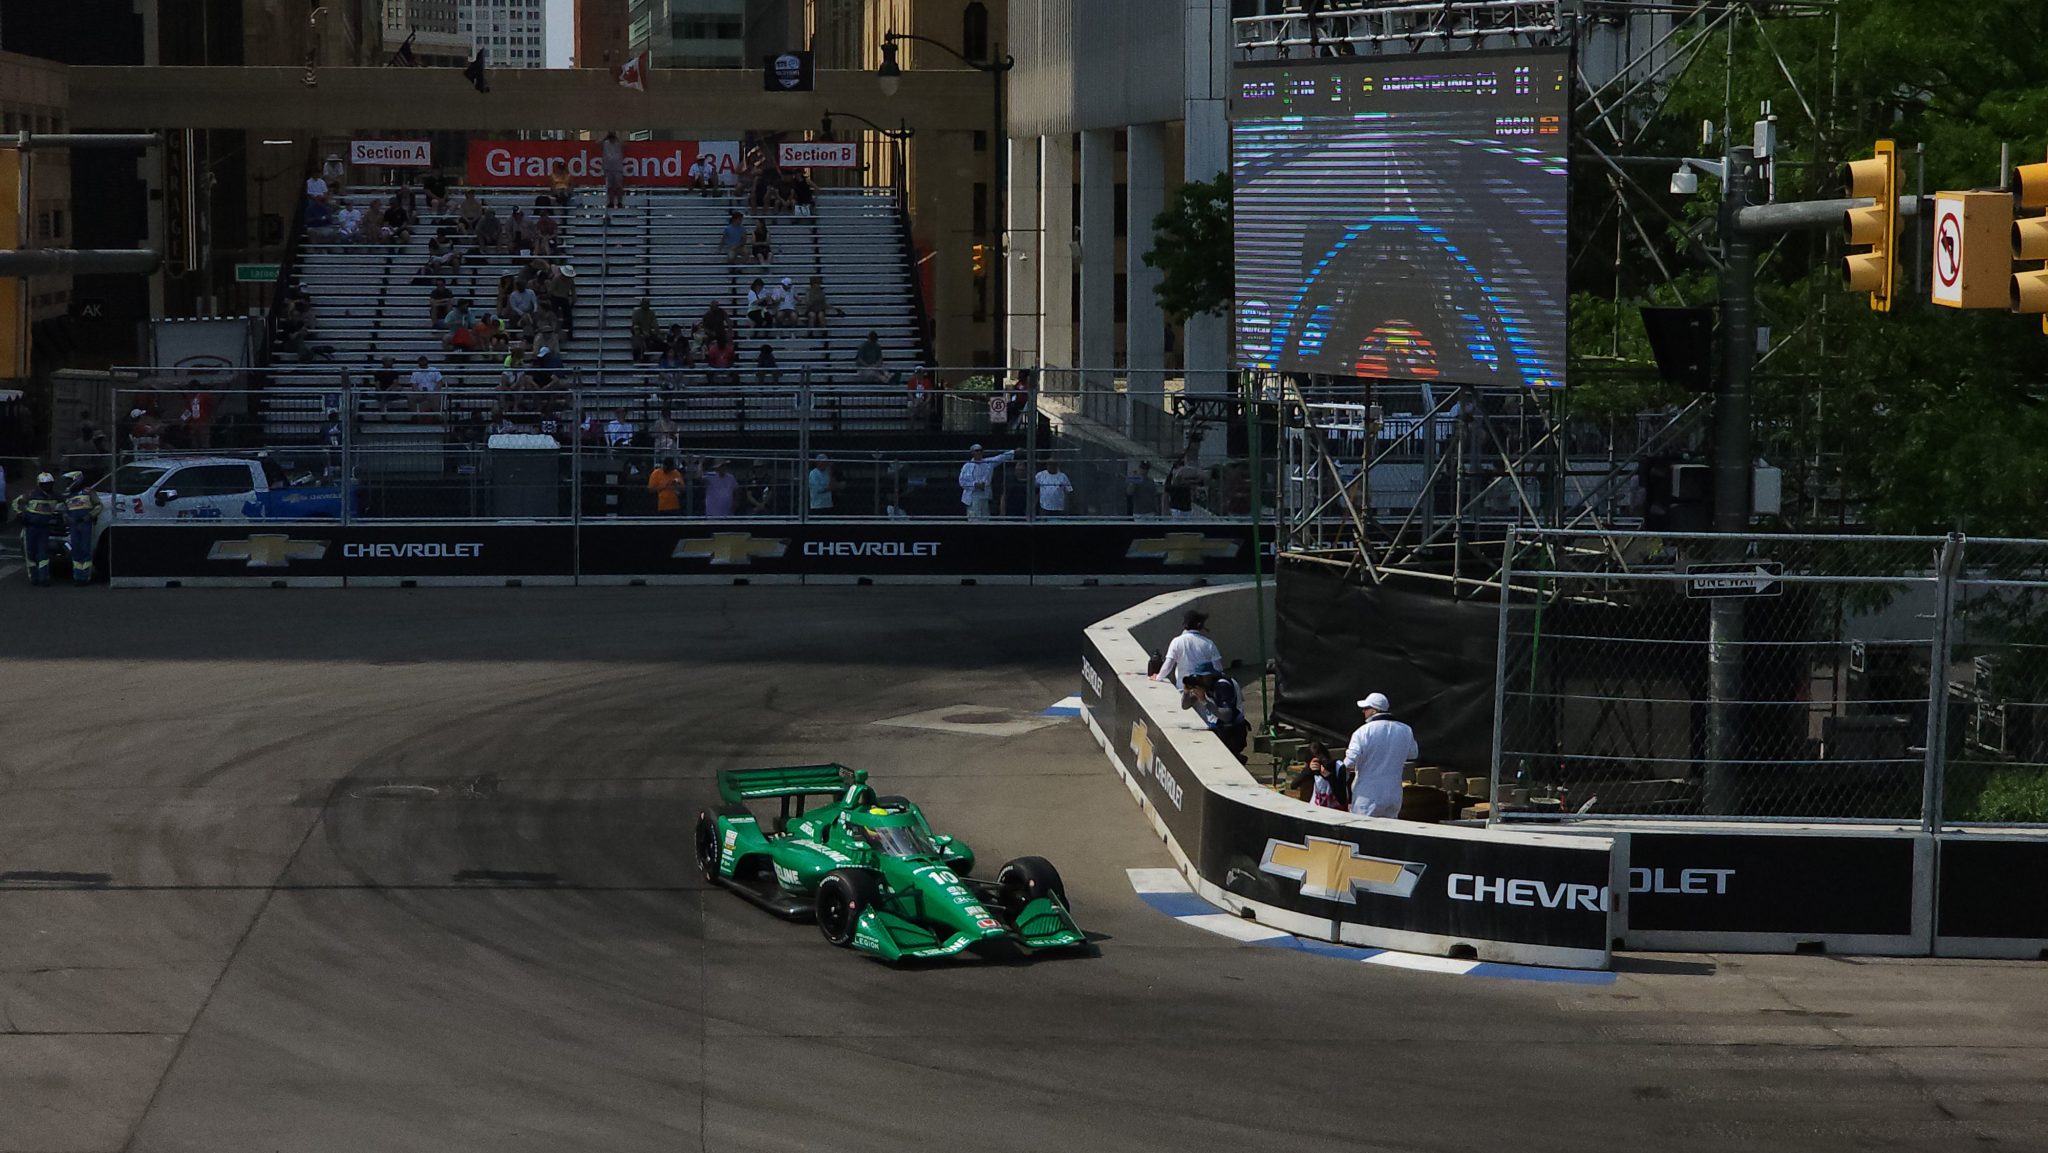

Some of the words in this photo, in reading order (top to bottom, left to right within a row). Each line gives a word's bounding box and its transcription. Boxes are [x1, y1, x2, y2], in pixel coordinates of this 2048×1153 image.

[356, 145, 411, 159] Section
[415, 145, 426, 160] A
[785, 147, 837, 161] Section
[841, 147, 851, 161] B
[485, 148, 682, 177] Grandsand
[343, 543, 484, 558] CHEVROLET
[803, 541, 942, 556] CHEVROLET
[1155, 756, 1184, 812] CHEVROLET
[928, 870, 959, 885] 10
